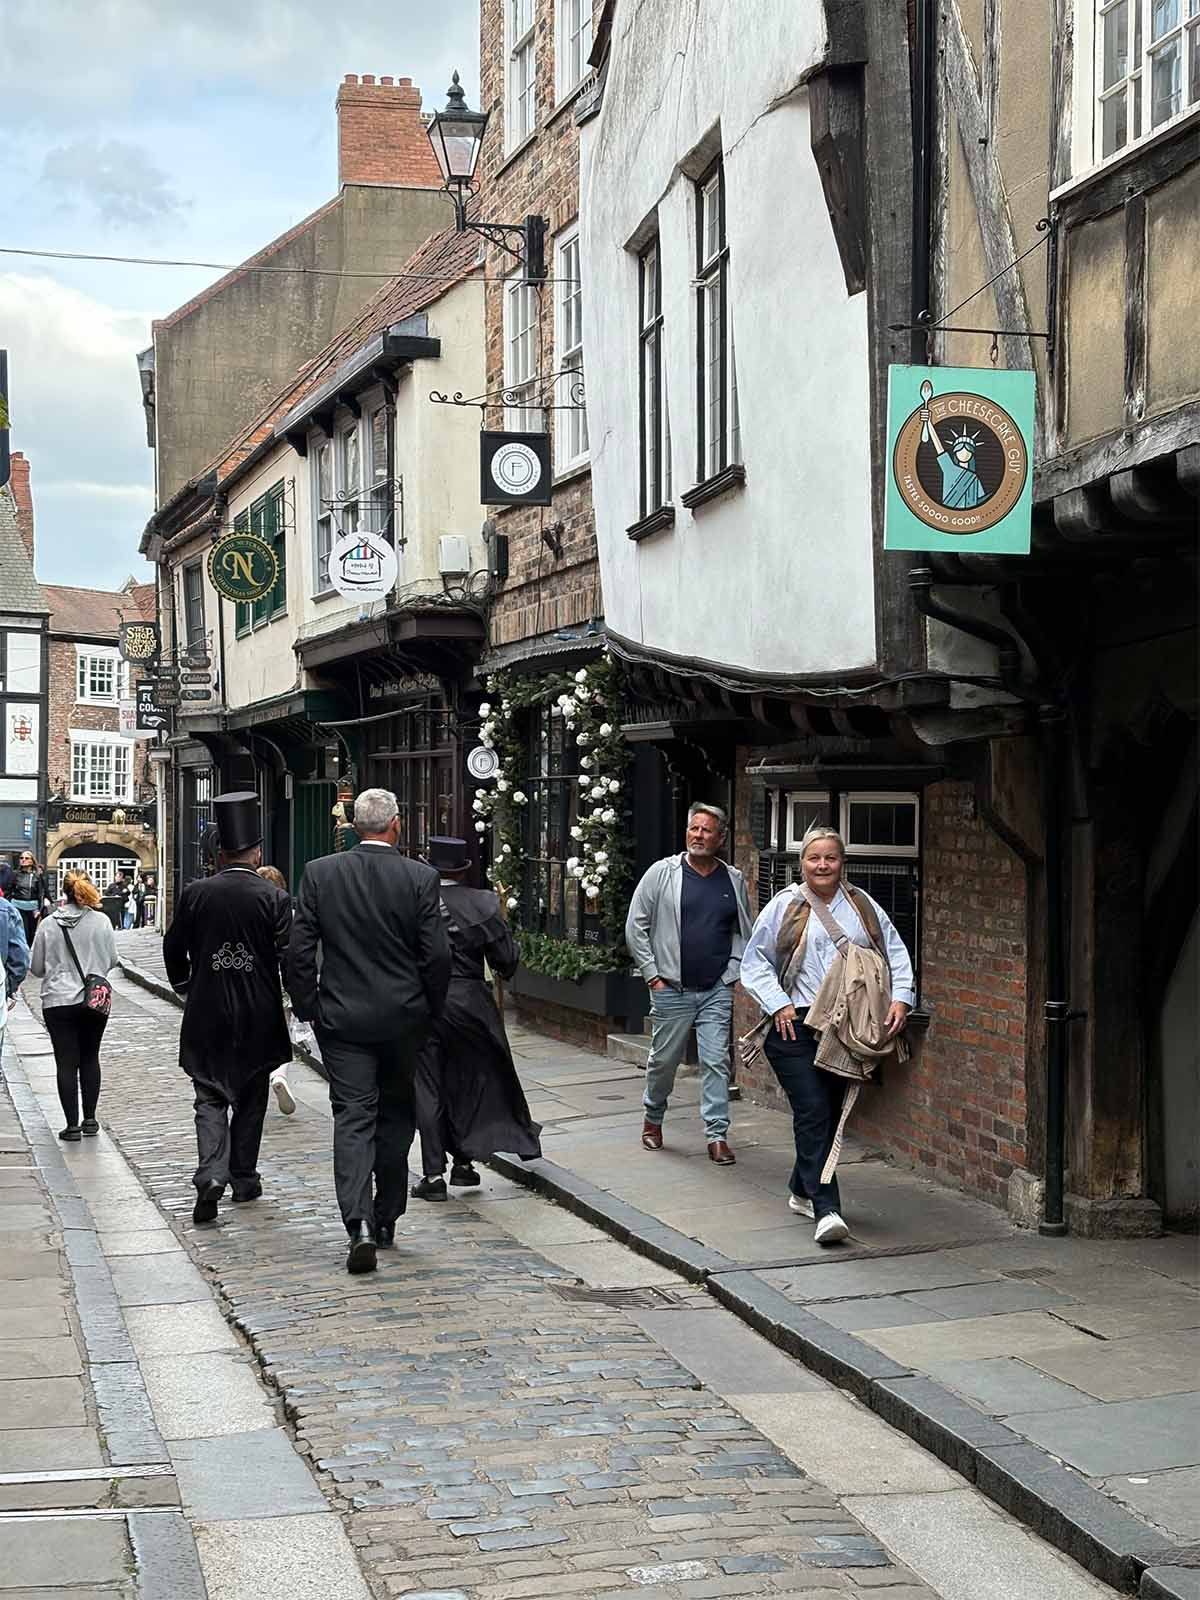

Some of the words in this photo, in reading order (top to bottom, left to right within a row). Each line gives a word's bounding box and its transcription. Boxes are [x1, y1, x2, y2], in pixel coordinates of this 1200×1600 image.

[948, 399, 1016, 446] CHEESECAKE
[1007, 448, 1021, 474] GUY
[511, 462, 523, 477] F
[903, 475, 921, 501] TASTES
[918, 501, 949, 524] SOOOO
[222, 551, 265, 586] N
[126, 627, 154, 640] SHOP
[124, 643, 143, 654] NOT
[65, 809, 97, 821] Golden
